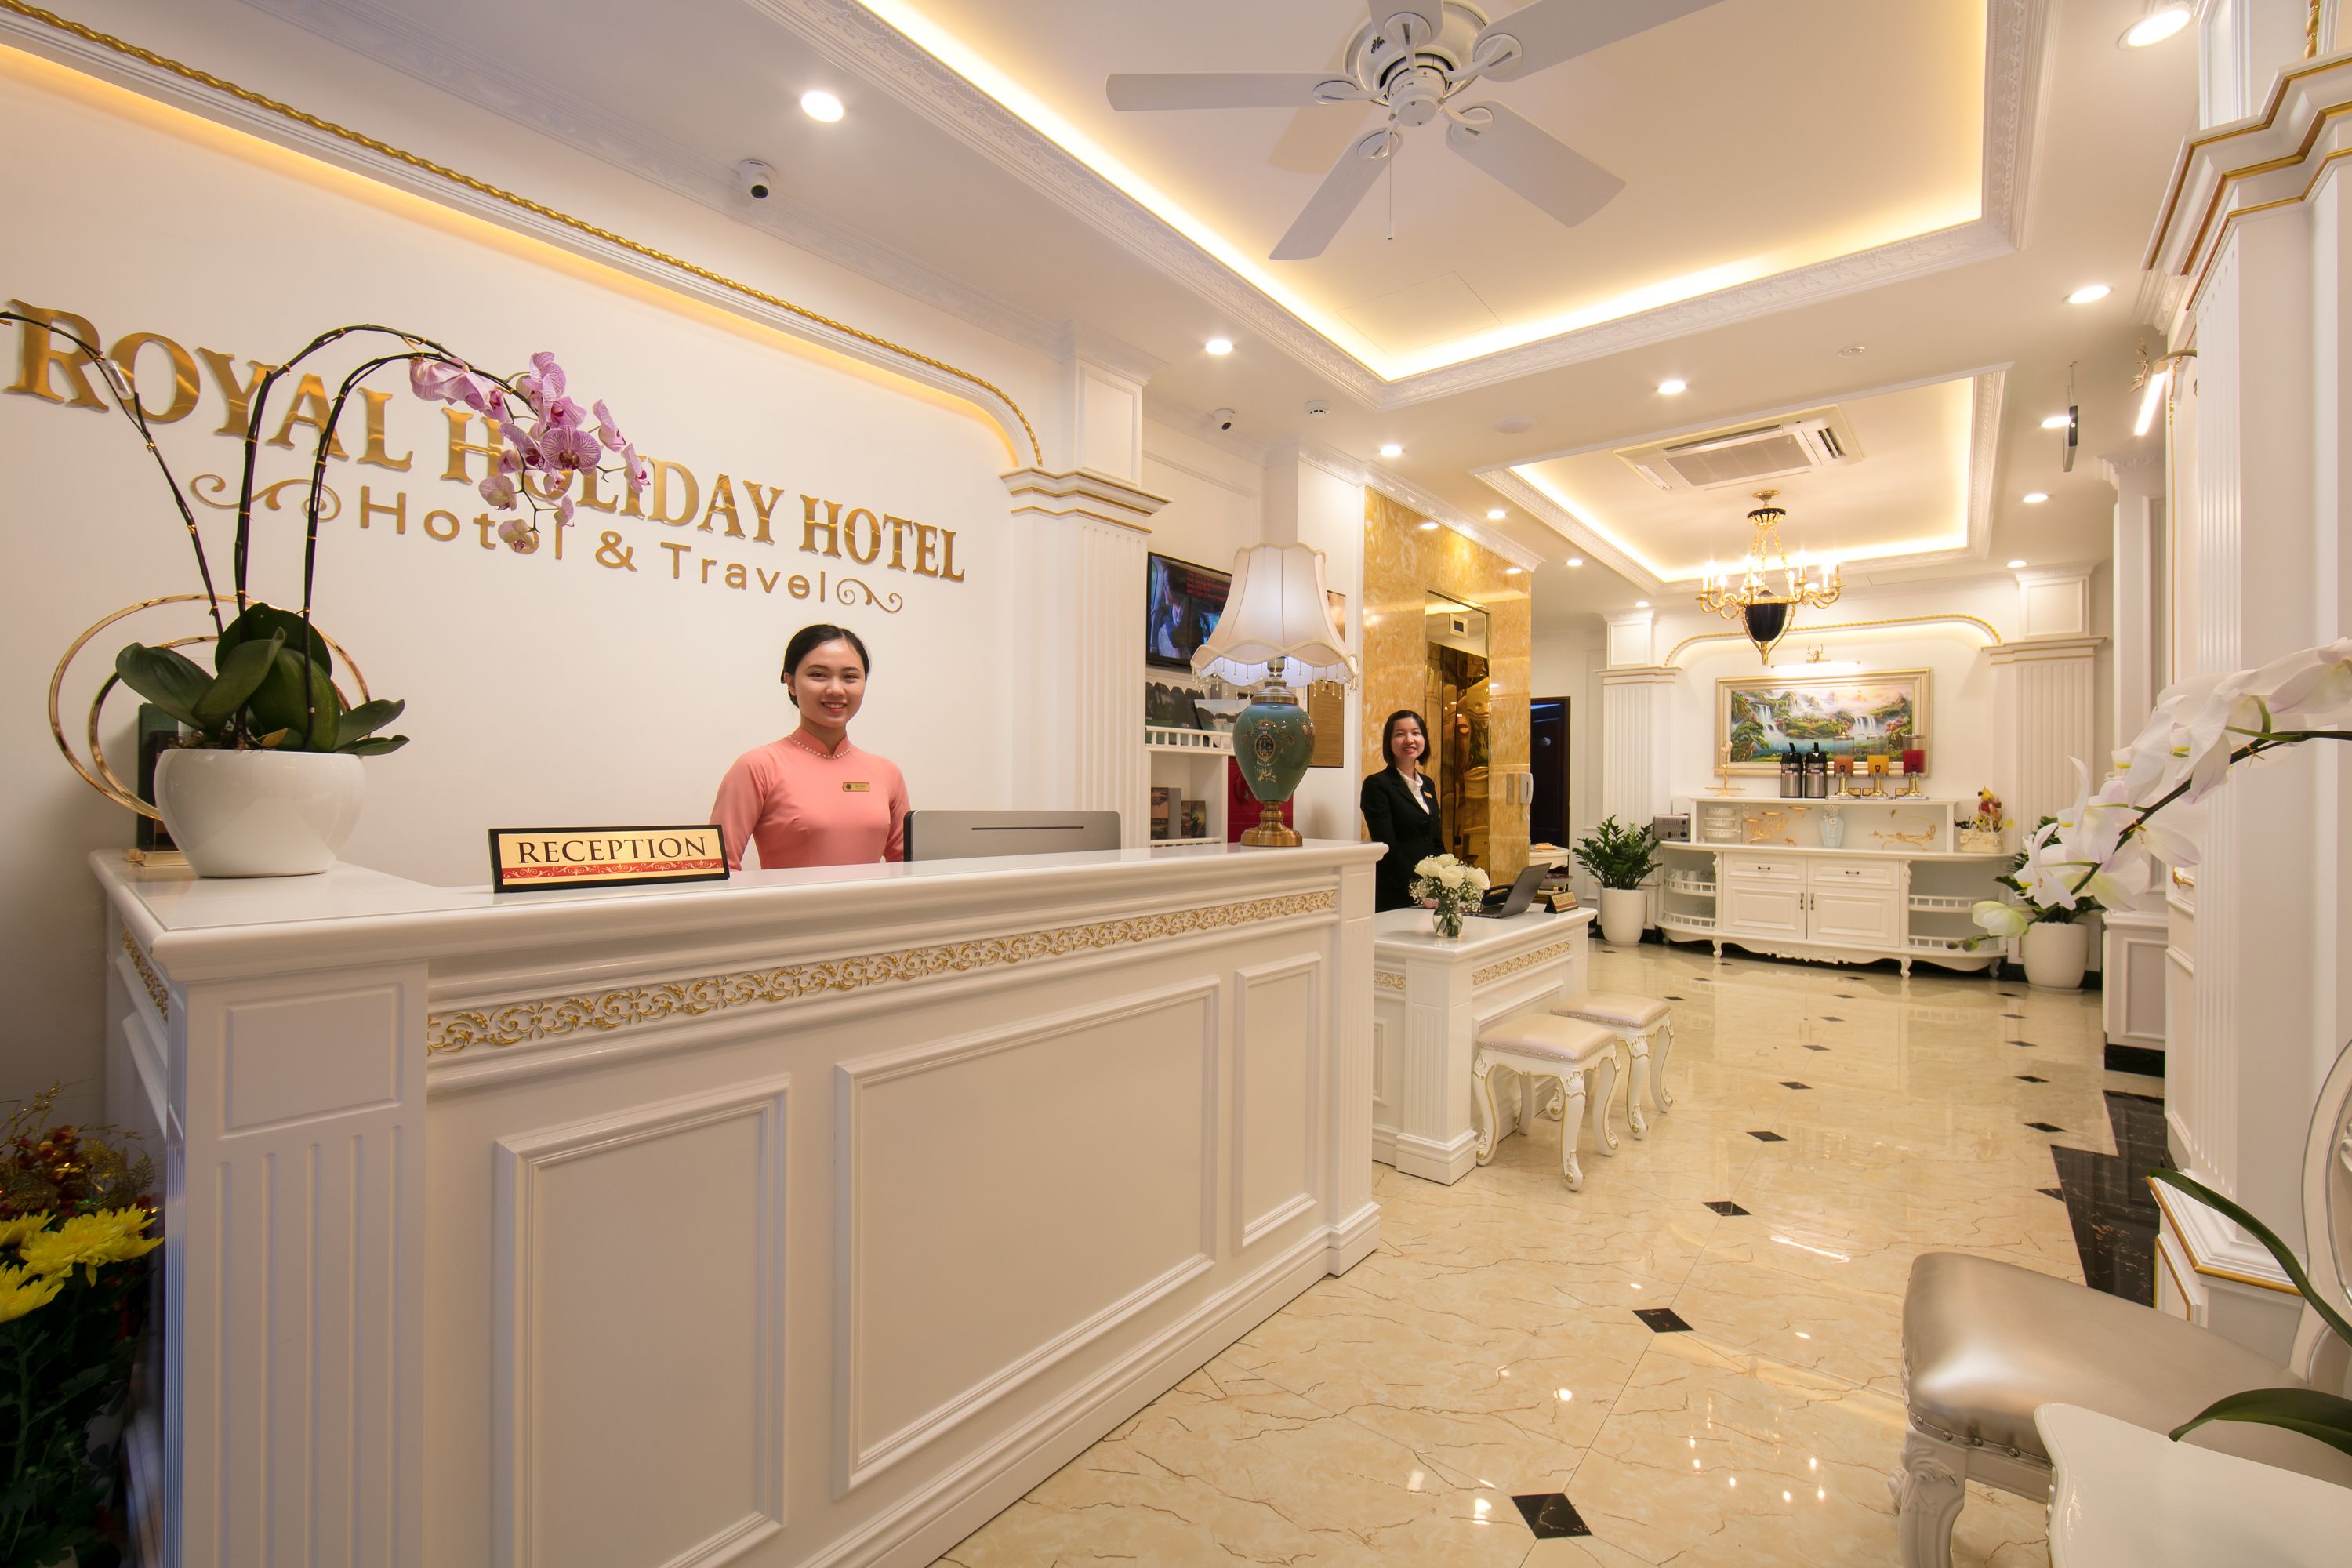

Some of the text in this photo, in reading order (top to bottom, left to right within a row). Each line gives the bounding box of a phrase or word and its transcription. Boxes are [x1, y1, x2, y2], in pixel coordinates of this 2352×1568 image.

[7, 298, 414, 470] ROYAL
[798, 494, 965, 583] HOTEL
[595, 530, 637, 572] &
[660, 540, 826, 603] Travel
[516, 836, 706, 864] RECEPTION
